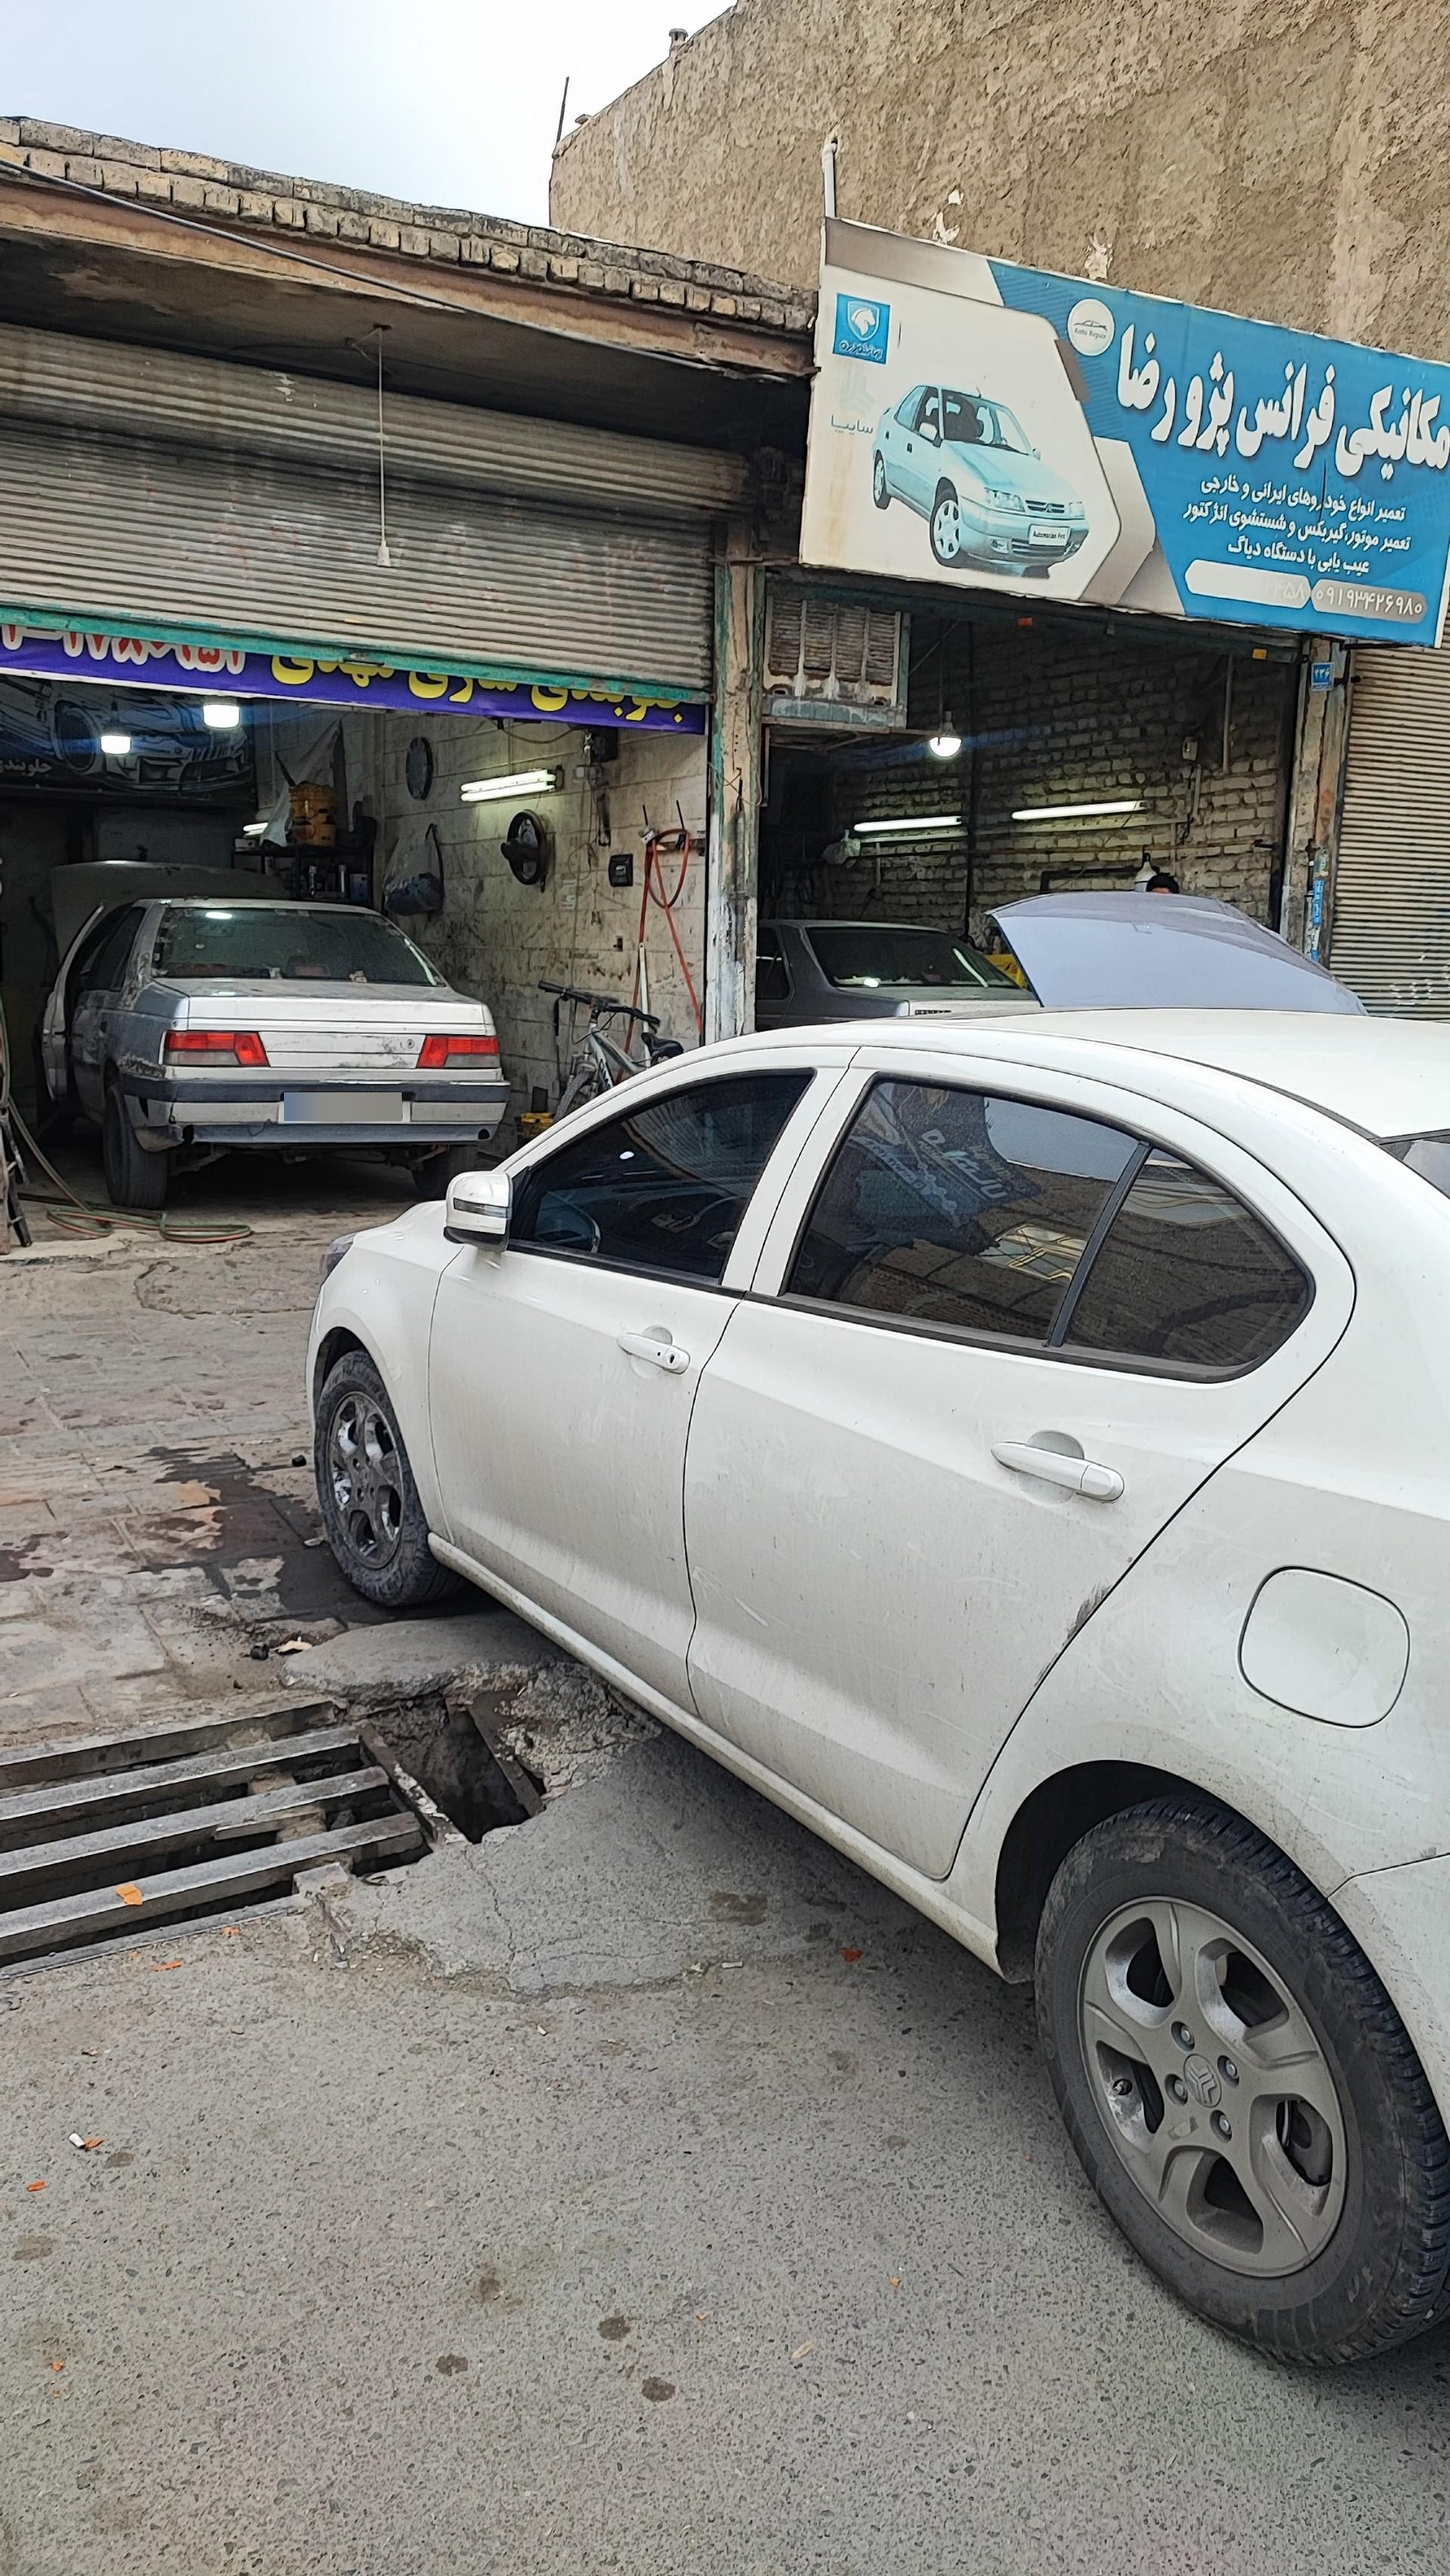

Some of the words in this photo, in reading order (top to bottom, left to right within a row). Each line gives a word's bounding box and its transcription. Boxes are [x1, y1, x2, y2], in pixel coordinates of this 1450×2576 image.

[1116, 323, 1176, 442] رضا
[1177, 351, 1235, 459] پژو
[1236, 360, 1337, 469] فرانس
[1335, 384, 1450, 481] مکانیکی
[1201, 474, 1241, 494] خارجی
[1241, 482, 1250, 500] و
[1251, 481, 1287, 505] ایرانی
[1229, 508, 1287, 531] شستشوی
[1348, 497, 1376, 522] انواع
[1374, 505, 1407, 524] تعمیر
[1287, 520, 1297, 538] و
[1227, 534, 1262, 561] دیاگ
[1263, 540, 1307, 563] دستگاه
[1379, 536, 1412, 553] تعمیر
[1307, 548, 1316, 570] با
